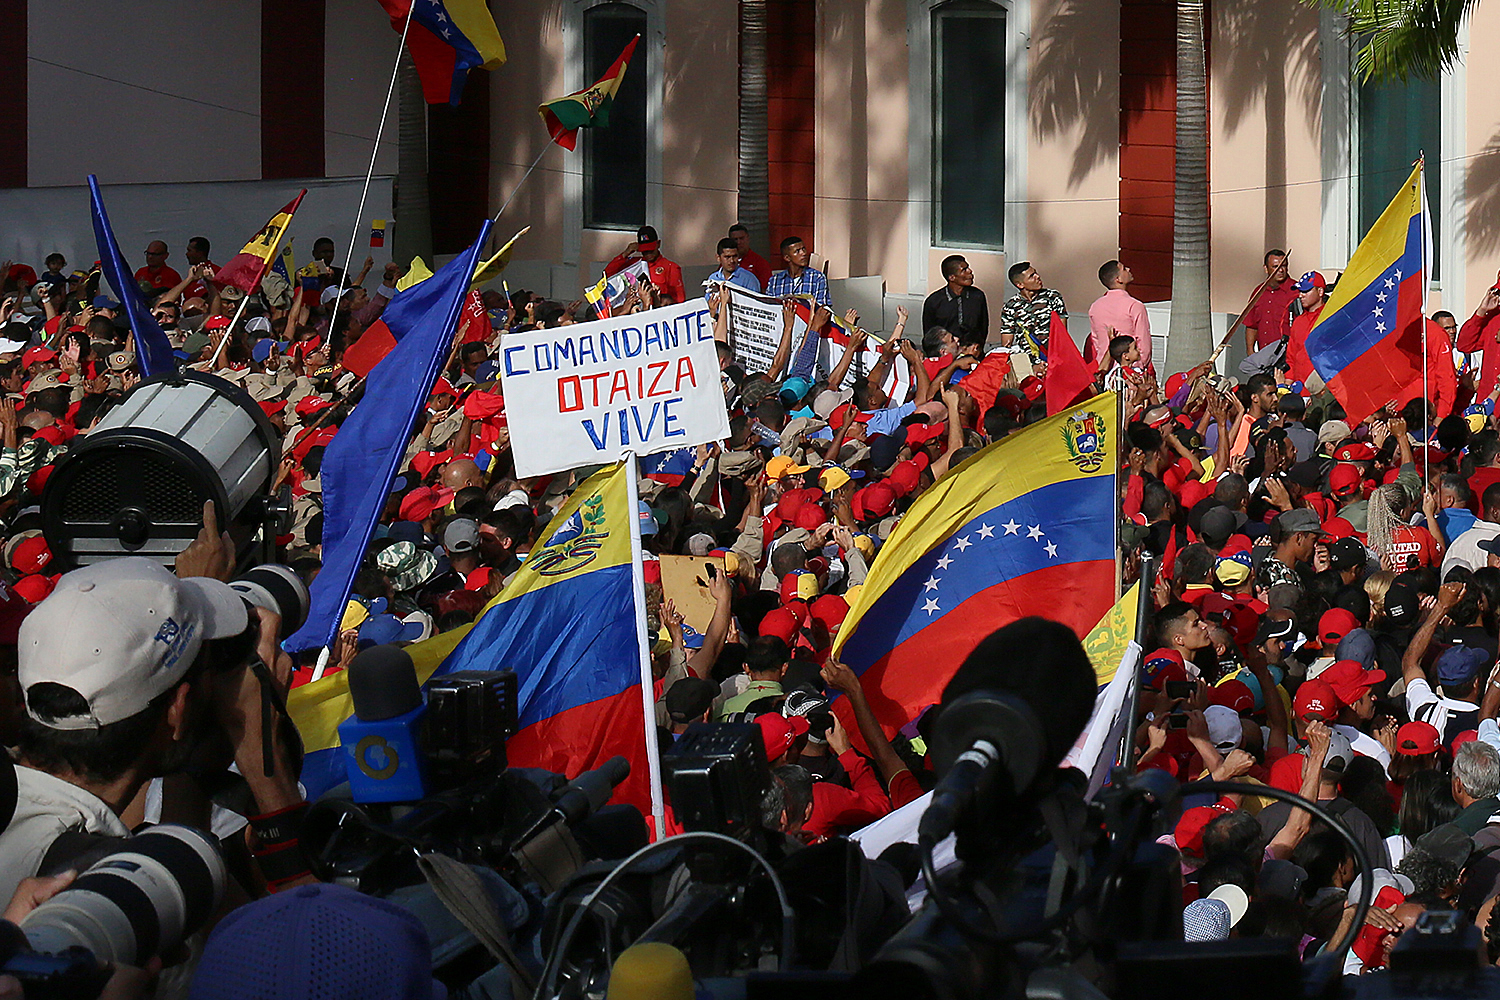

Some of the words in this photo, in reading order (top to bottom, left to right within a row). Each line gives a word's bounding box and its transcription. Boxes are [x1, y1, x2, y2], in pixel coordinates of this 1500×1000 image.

[504, 309, 714, 377] COMANDANTE
[557, 356, 697, 413] OTAIZA
[581, 397, 686, 450] VIVE
